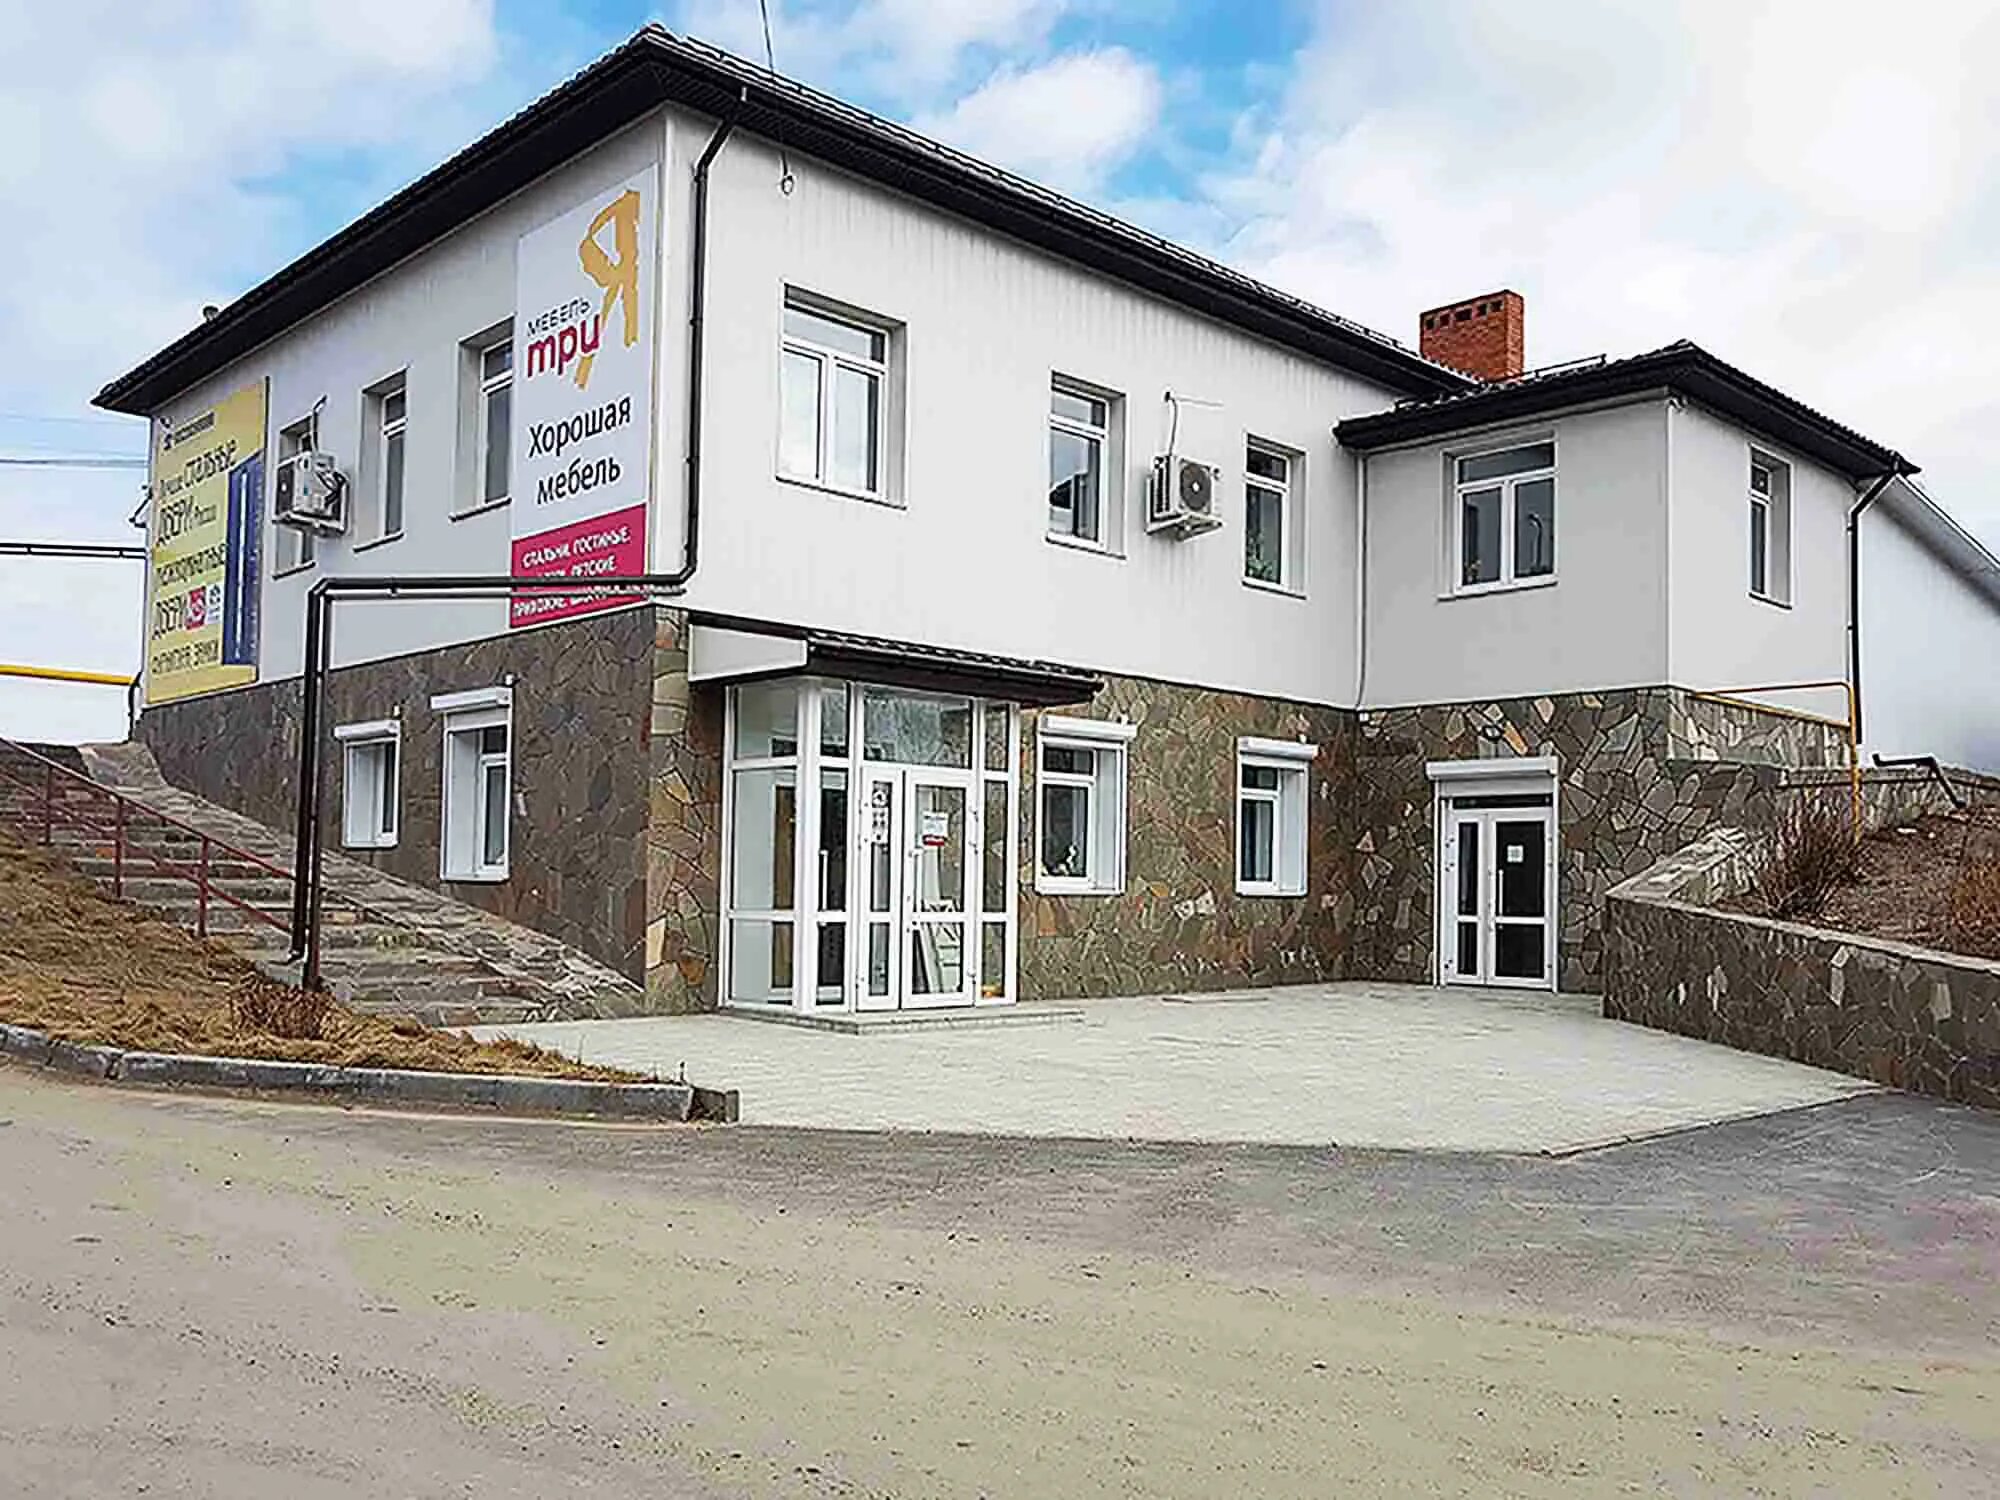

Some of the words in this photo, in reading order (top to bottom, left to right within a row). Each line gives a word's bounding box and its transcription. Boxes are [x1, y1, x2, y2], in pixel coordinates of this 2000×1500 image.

[528, 297, 591, 336] МЕБЕЛЬ
[528, 396, 631, 458] Хорошая
[537, 457, 621, 505] мебель
